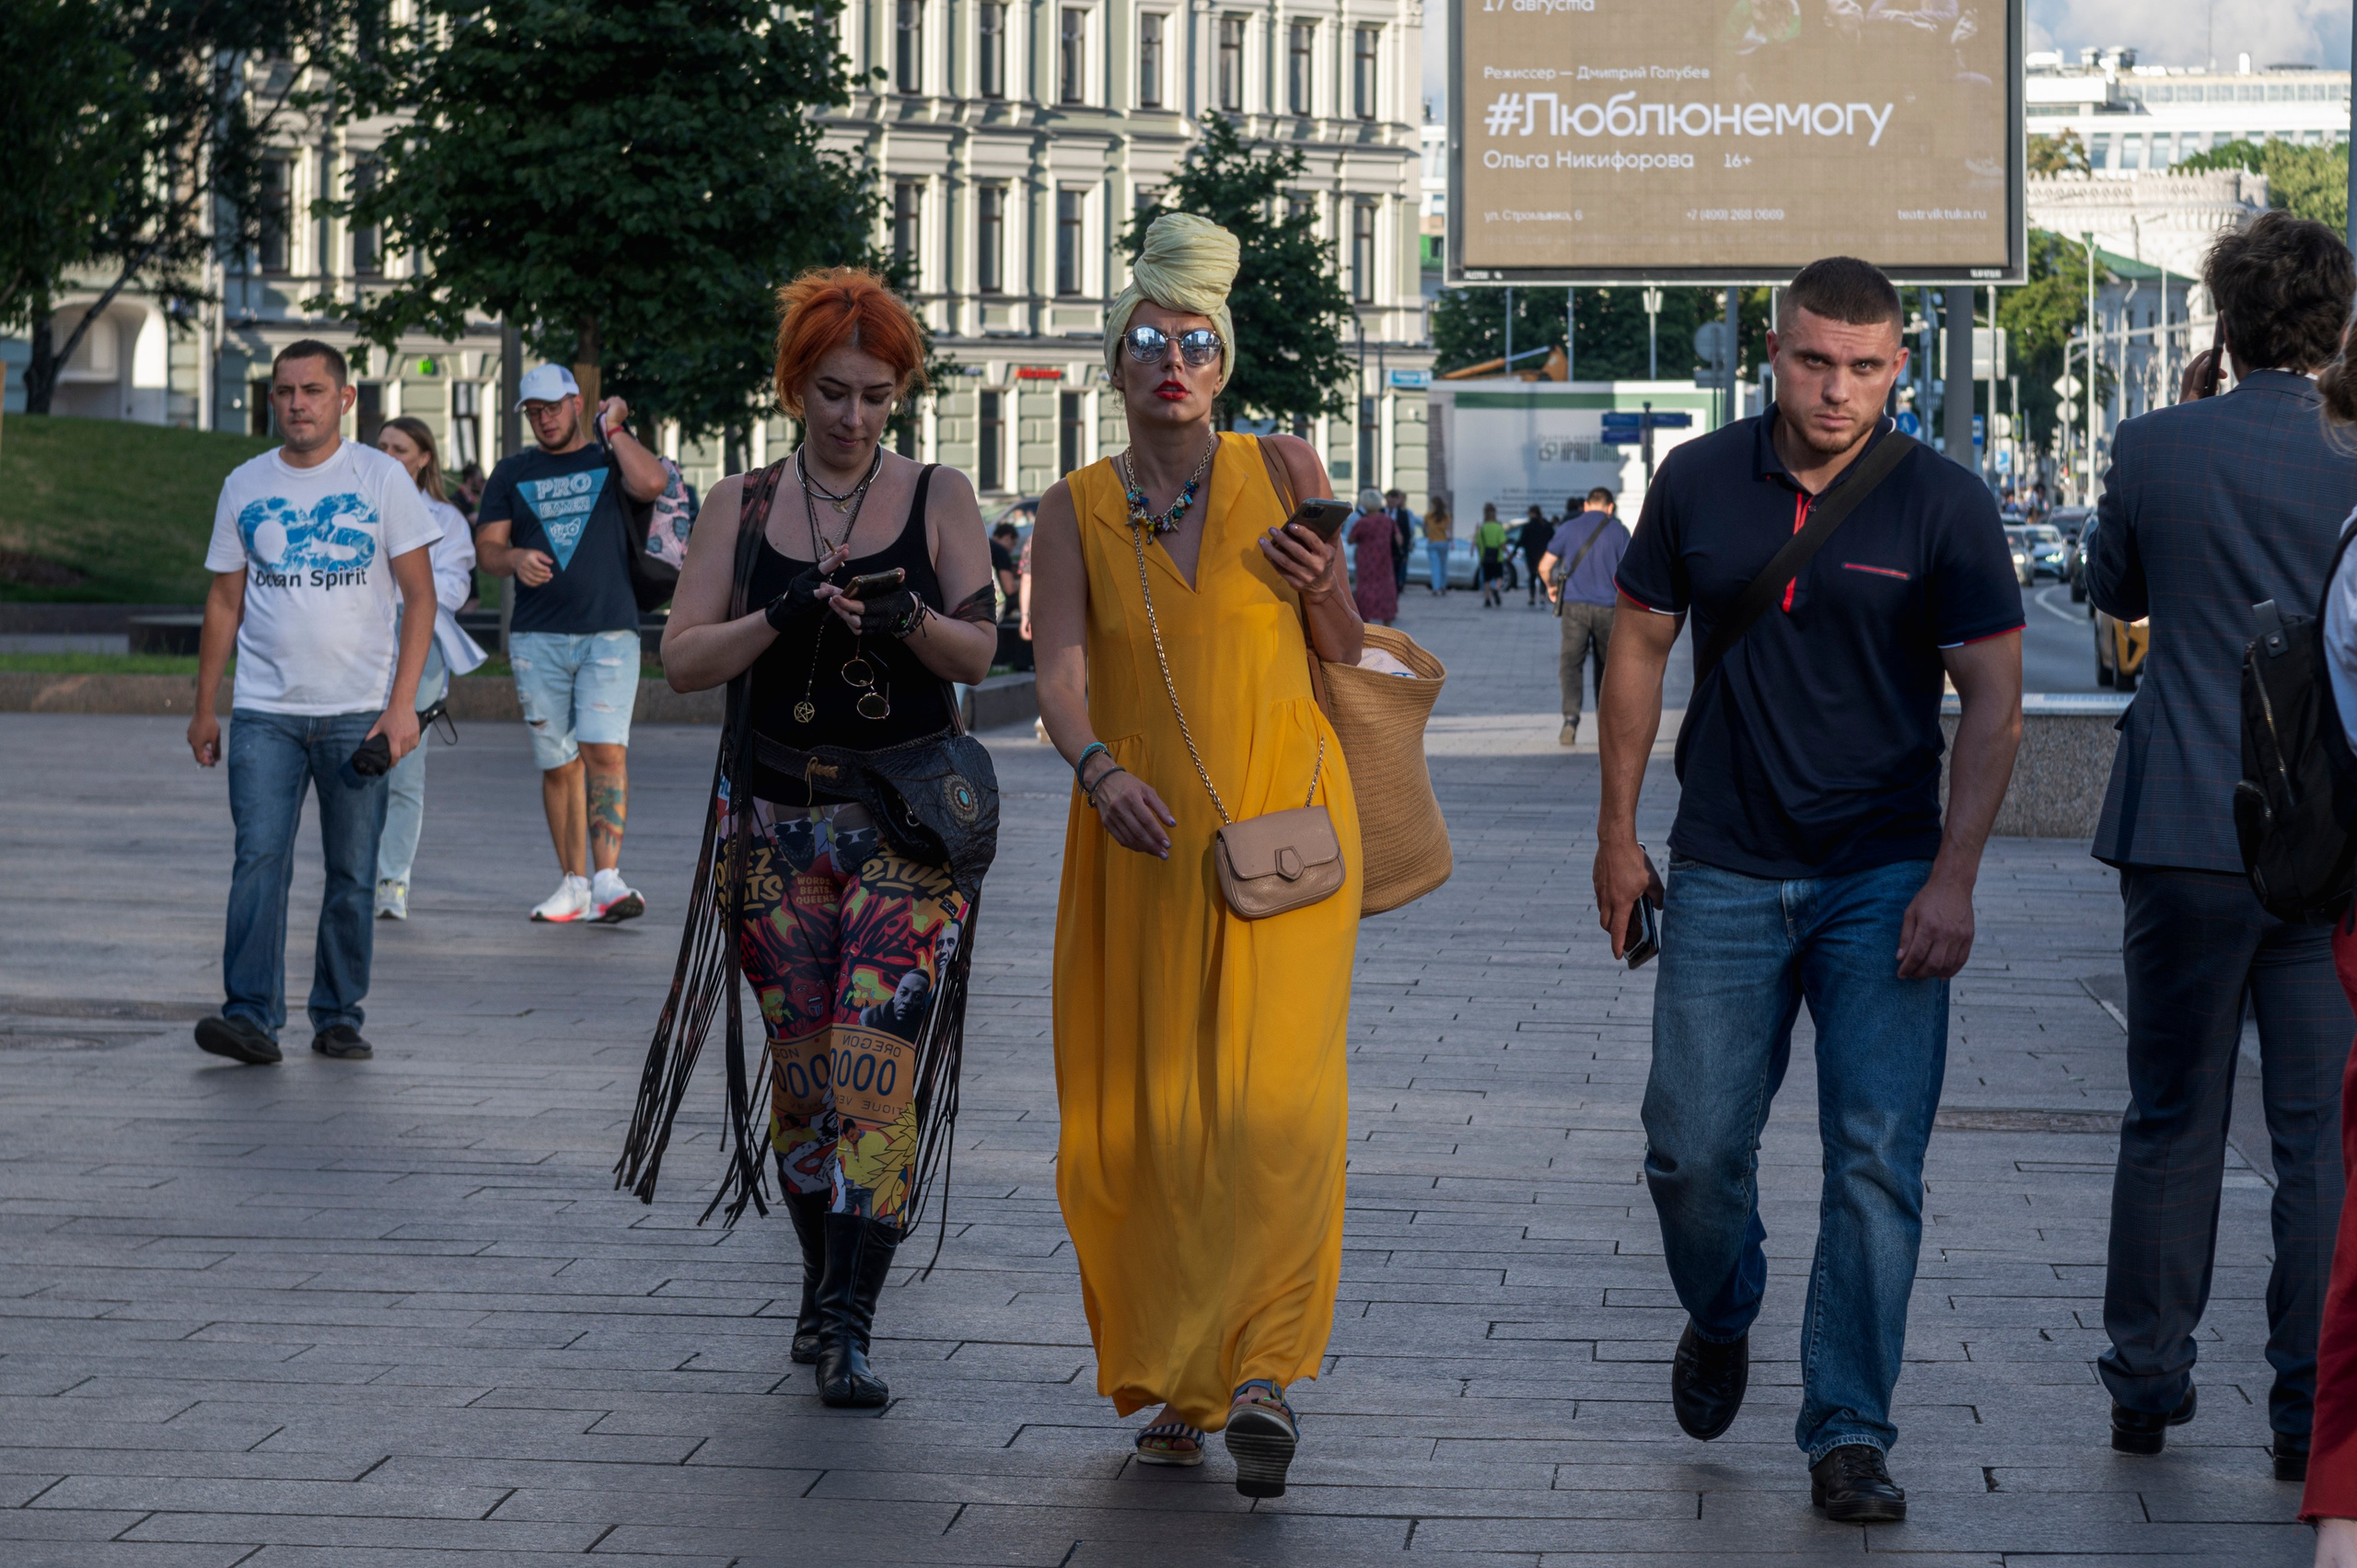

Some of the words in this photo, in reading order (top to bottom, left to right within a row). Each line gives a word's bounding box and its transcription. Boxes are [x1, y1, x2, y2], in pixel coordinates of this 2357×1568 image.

[1483, 65, 1557, 81] Режиссер
[1576, 65, 1647, 81] Дмитрий
[1650, 65, 1711, 81] Голубев
[1483, 90, 1895, 146] #Люблюнемогу
[1483, 149, 1550, 169] Ольга
[1556, 149, 1695, 173] Никифорова
[1724, 153, 1753, 168] 16+
[536, 472, 592, 499] PRO
[540, 497, 589, 517] GAMER
[310, 567, 367, 591] Spirit
[796, 876, 833, 886] WORDS.
[800, 886, 832, 895] BEATS.
